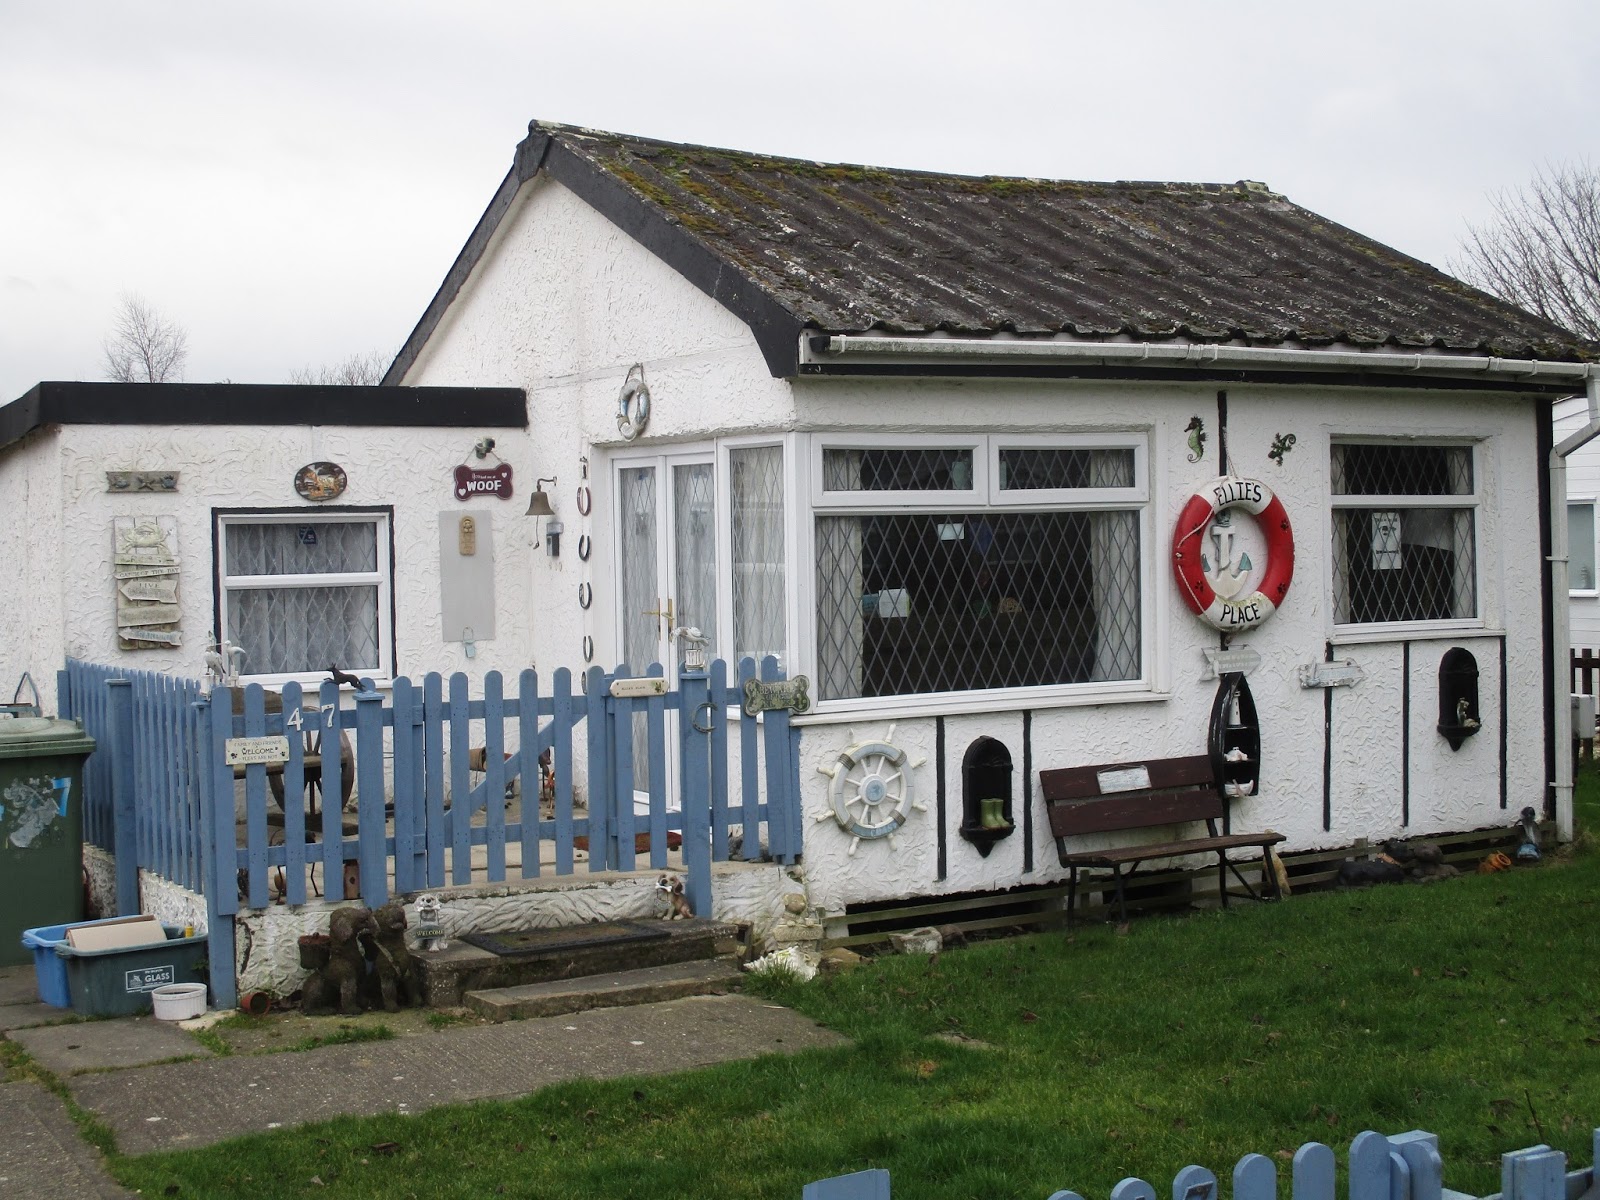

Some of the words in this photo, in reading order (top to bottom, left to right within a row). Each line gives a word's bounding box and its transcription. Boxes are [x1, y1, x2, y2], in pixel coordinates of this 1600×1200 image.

[466, 480, 502, 491] WOOF
[1213, 482, 1262, 506] ELLIE'S
[1220, 603, 1261, 624] PLACE
[145, 972, 170, 982] GLASS
